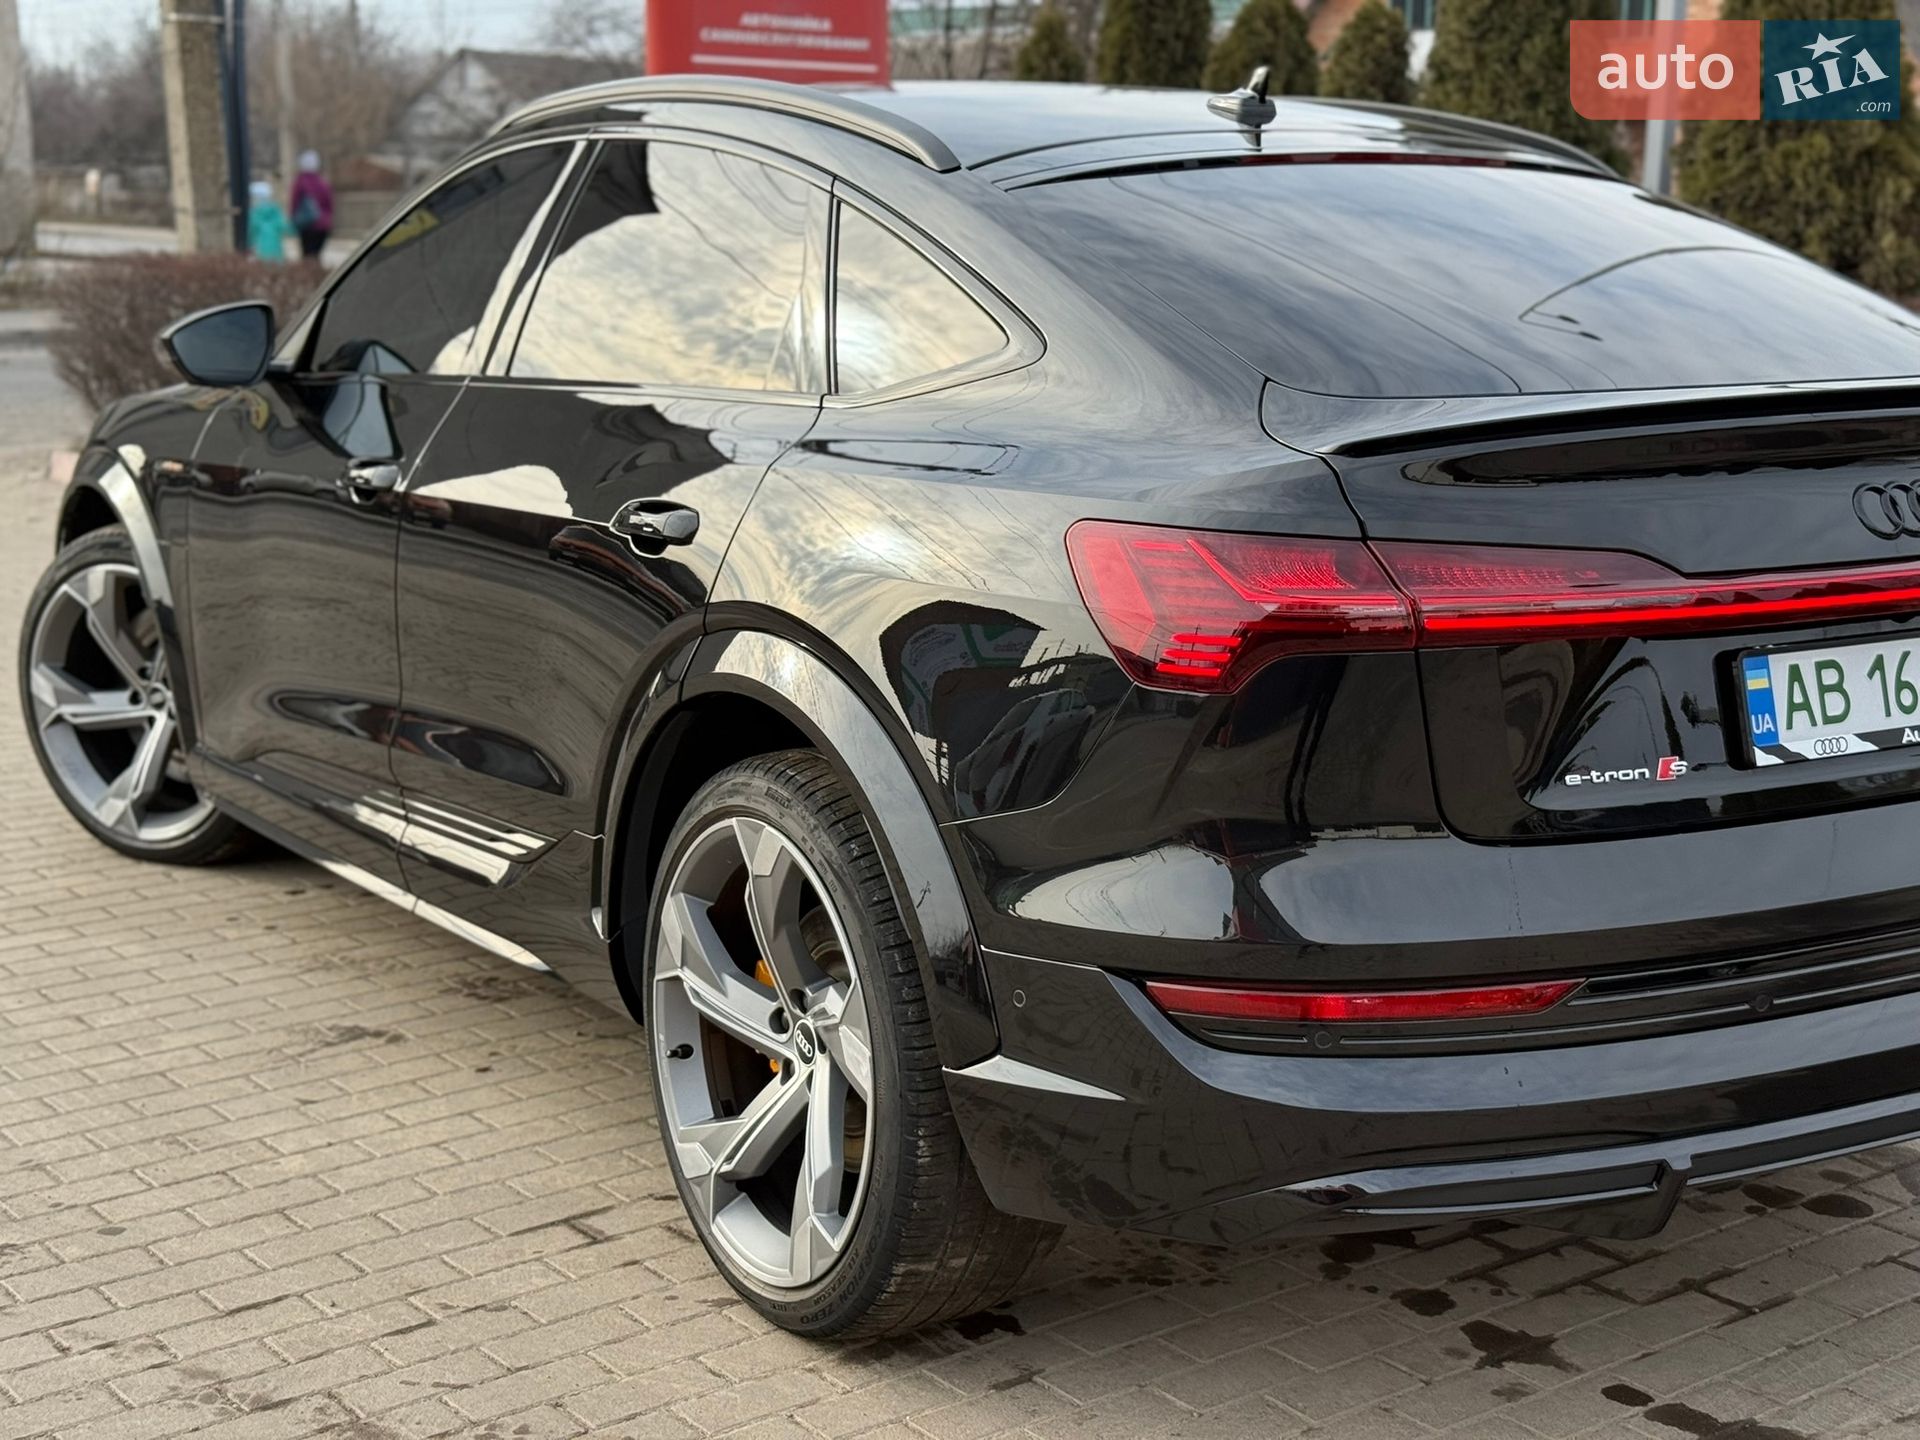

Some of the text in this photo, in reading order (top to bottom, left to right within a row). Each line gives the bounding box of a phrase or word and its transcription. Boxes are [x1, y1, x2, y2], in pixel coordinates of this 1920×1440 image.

[1786, 650, 1919, 730] AB 16
[1751, 713, 1775, 734] UA
[1564, 767, 1650, 786] e-tron
